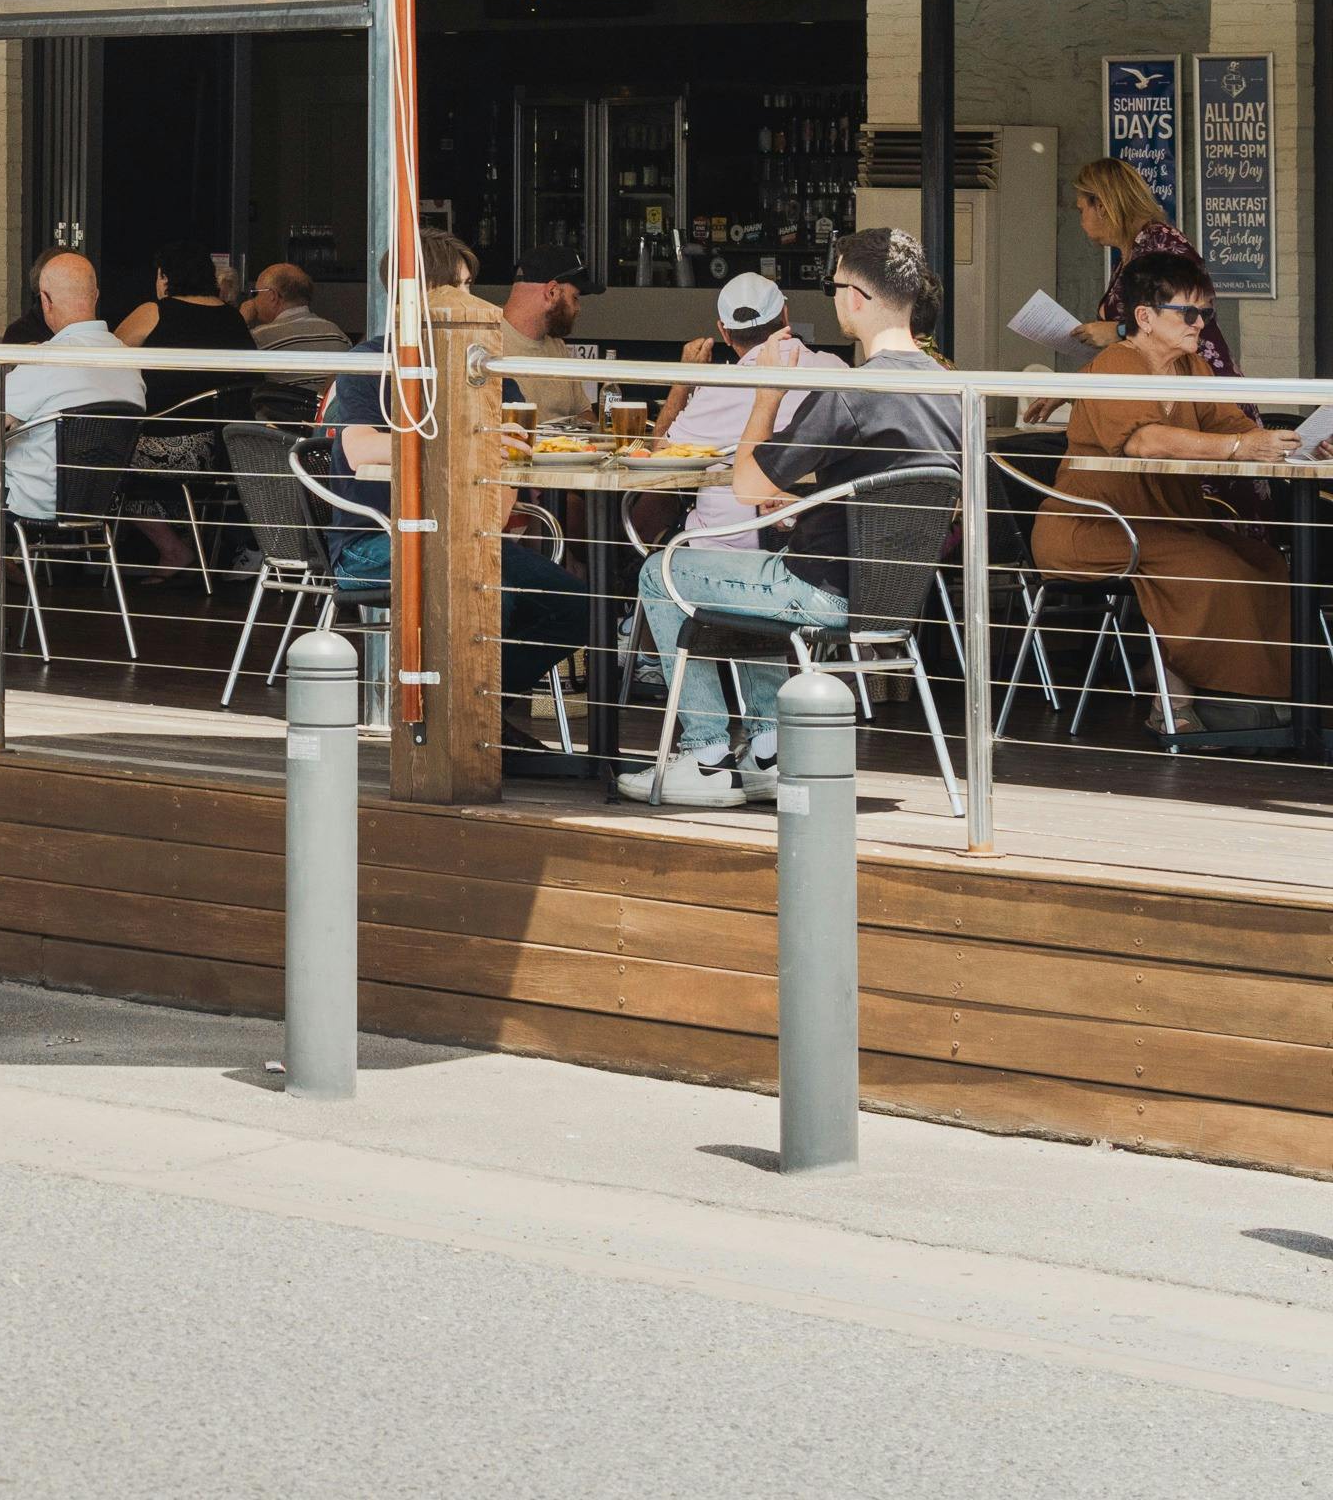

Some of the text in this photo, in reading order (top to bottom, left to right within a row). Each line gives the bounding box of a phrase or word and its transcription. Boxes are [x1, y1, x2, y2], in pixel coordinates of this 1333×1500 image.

[1113, 97, 1173, 112] SCHNITZEL
[1204, 102, 1266, 123] ALL DAY
[1114, 113, 1173, 140] DAYS
[1204, 122, 1266, 142] DINING
[1119, 143, 1166, 165] Mondays
[1205, 144, 1266, 159] 12PM-9PM
[1206, 160, 1263, 183] Every Day
[1206, 197, 1267, 211] BREAKFAST
[1206, 213, 1266, 227] 9AM-11AM
[1209, 228, 1264, 250] Saturday
[1219, 246, 1265, 269] Sunday
